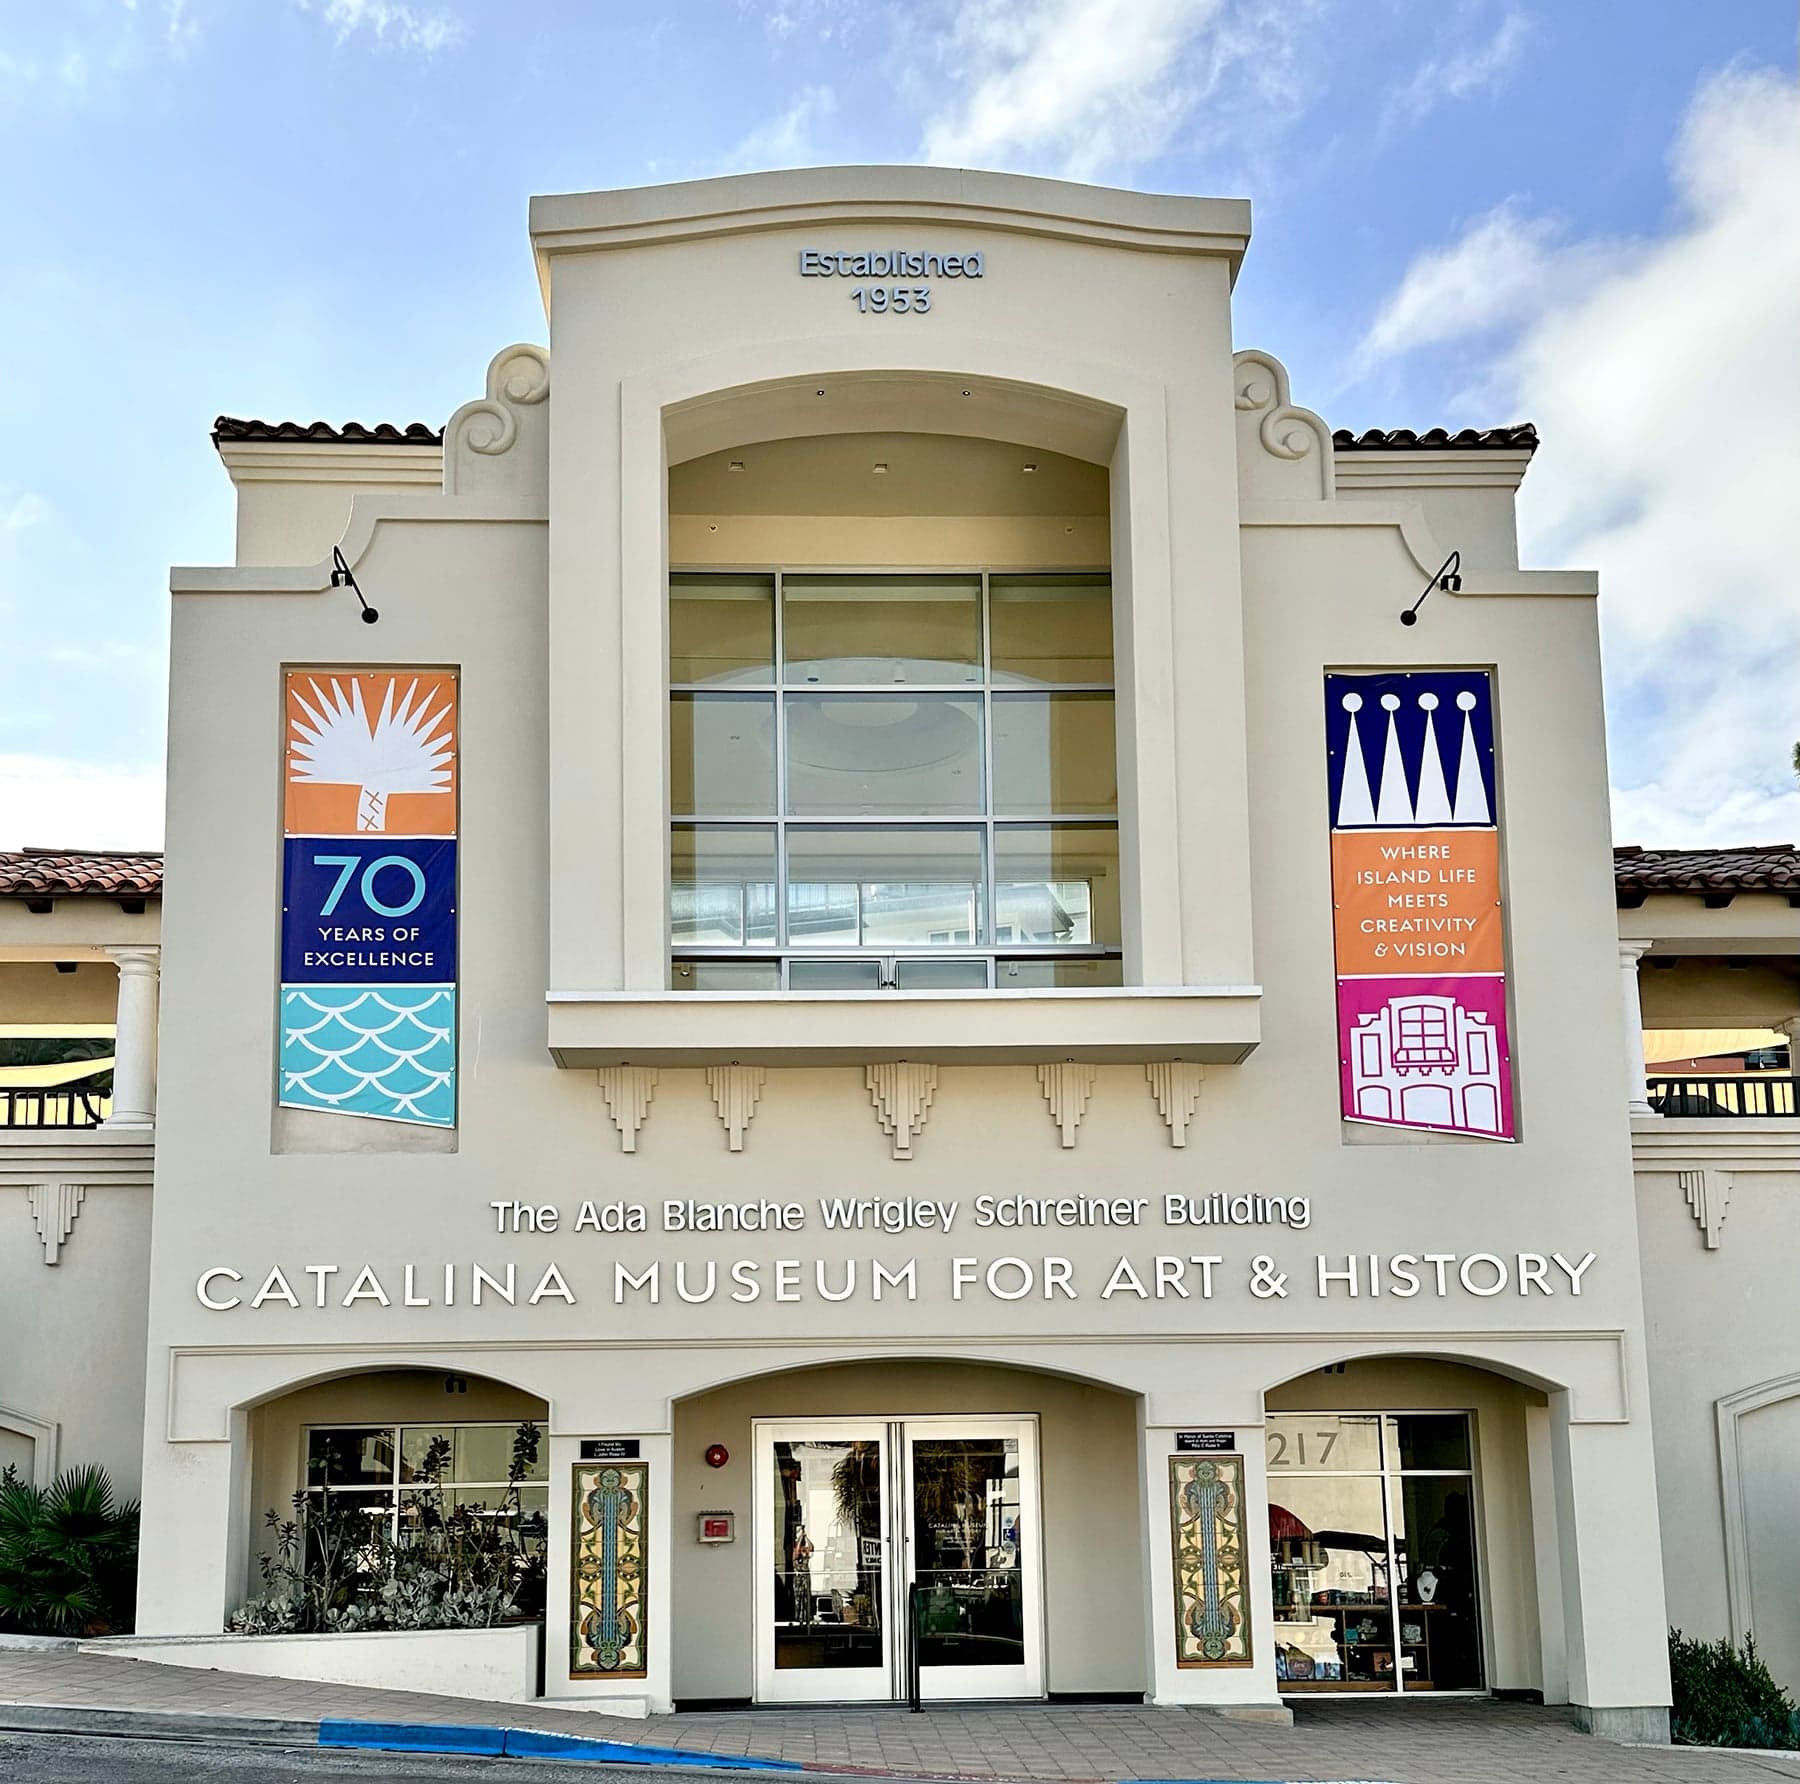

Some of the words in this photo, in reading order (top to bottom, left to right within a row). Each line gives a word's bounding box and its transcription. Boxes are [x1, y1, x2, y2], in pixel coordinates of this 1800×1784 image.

[799, 248, 985, 279] Established
[851, 285, 932, 314] 1953
[1380, 845, 1451, 860] WHERE
[1357, 870, 1431, 885] ISLAND
[1439, 869, 1476, 883] LIFE
[314, 855, 426, 917] 70
[1388, 893, 1449, 908] MEETS
[1360, 918, 1477, 933] CREATIVITY
[318, 927, 385, 942] YEARS
[392, 927, 420, 942] OF
[1374, 942, 1389, 957] &
[1393, 942, 1465, 957] VISION
[304, 952, 434, 966] EXCELLENCE
[491, 1200, 559, 1233] The
[574, 1200, 647, 1233] Ada
[663, 1198, 805, 1232] Blanche
[819, 1196, 959, 1234] Wrigley
[974, 1193, 1148, 1227] Schreiner
[1164, 1192, 1312, 1230] Building
[195, 1261, 577, 1311] CATALINA
[613, 1257, 917, 1305] MUSEUM
[951, 1255, 1078, 1300] FOR
[1100, 1255, 1223, 1299] ART
[1249, 1255, 1290, 1298] &
[1316, 1251, 1597, 1298] HISTORY
[1267, 1431, 1338, 1465] 217
